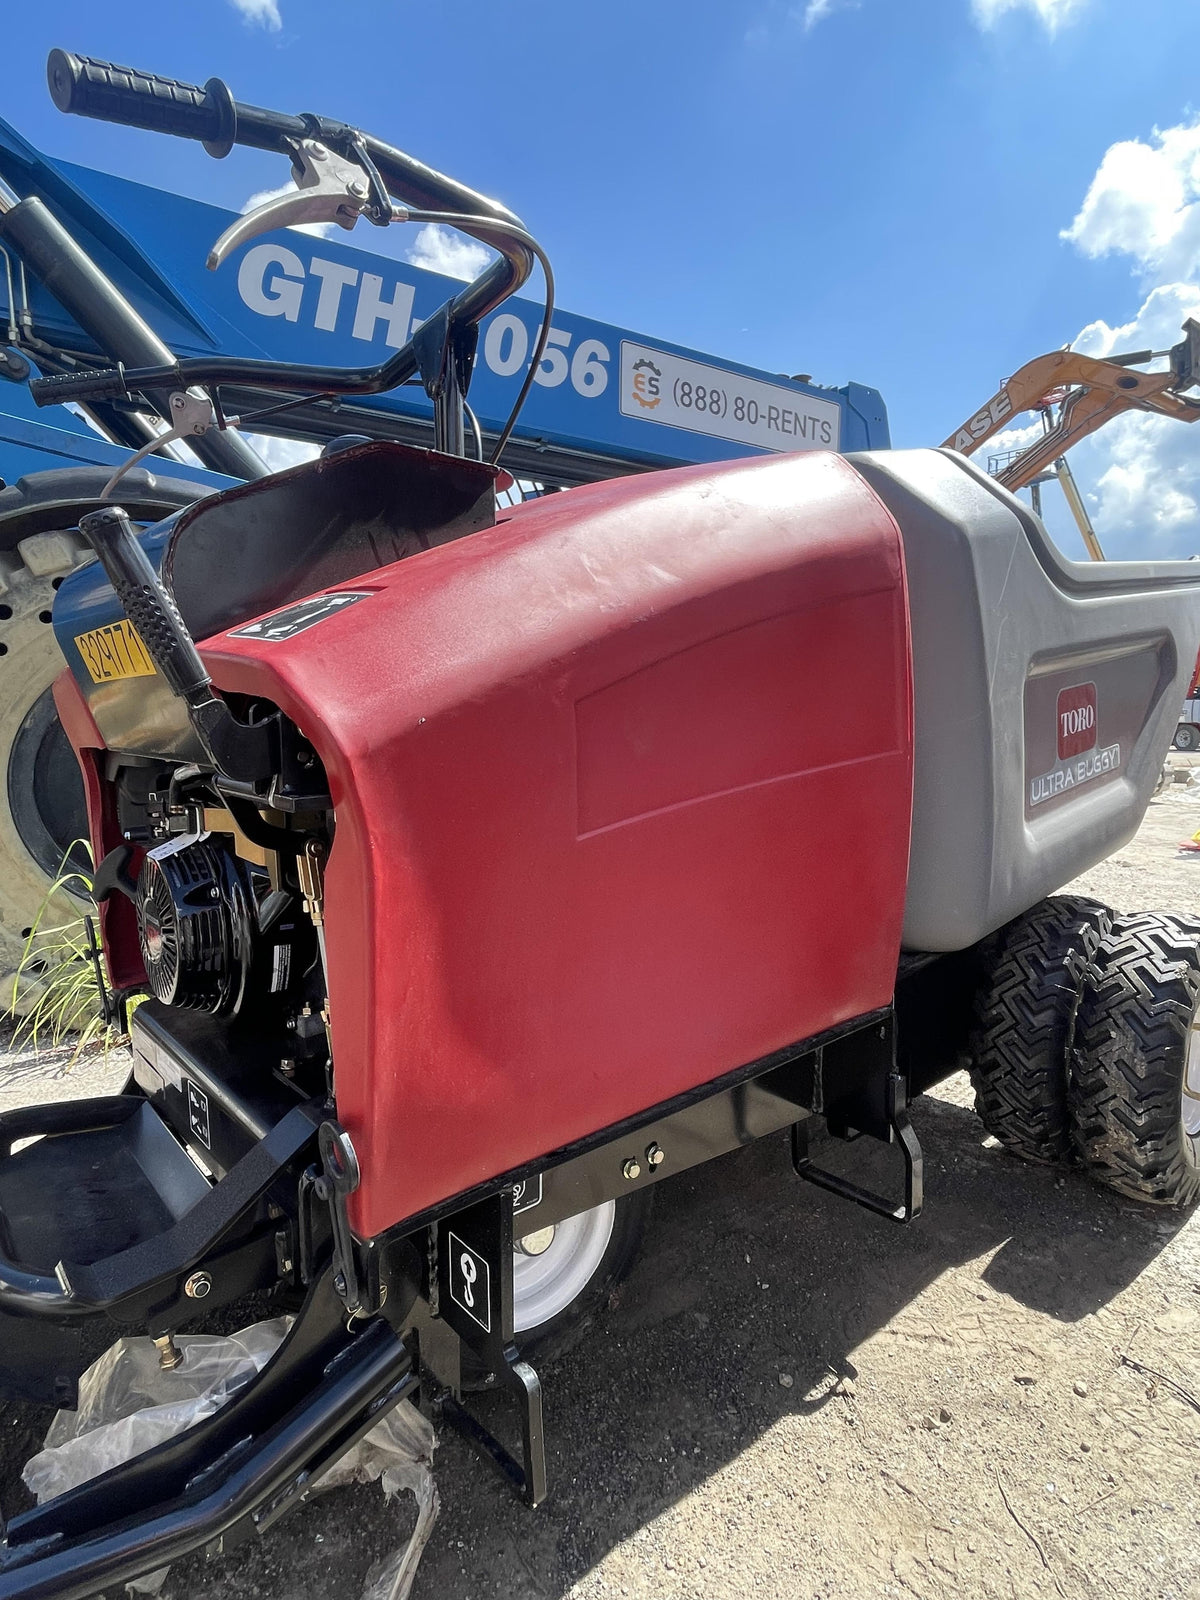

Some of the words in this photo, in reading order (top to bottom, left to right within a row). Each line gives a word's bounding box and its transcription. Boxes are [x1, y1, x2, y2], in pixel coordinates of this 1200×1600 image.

[237, 244, 611, 398] GTH-056
[673, 377, 728, 419] (888)
[733, 396, 832, 444] 80-RENTS
[943, 391, 1012, 451] ASE
[1061, 704, 1095, 738] TORO
[1032, 767, 1074, 801] ULTRA
[1077, 747, 1117, 781] BUGGY
